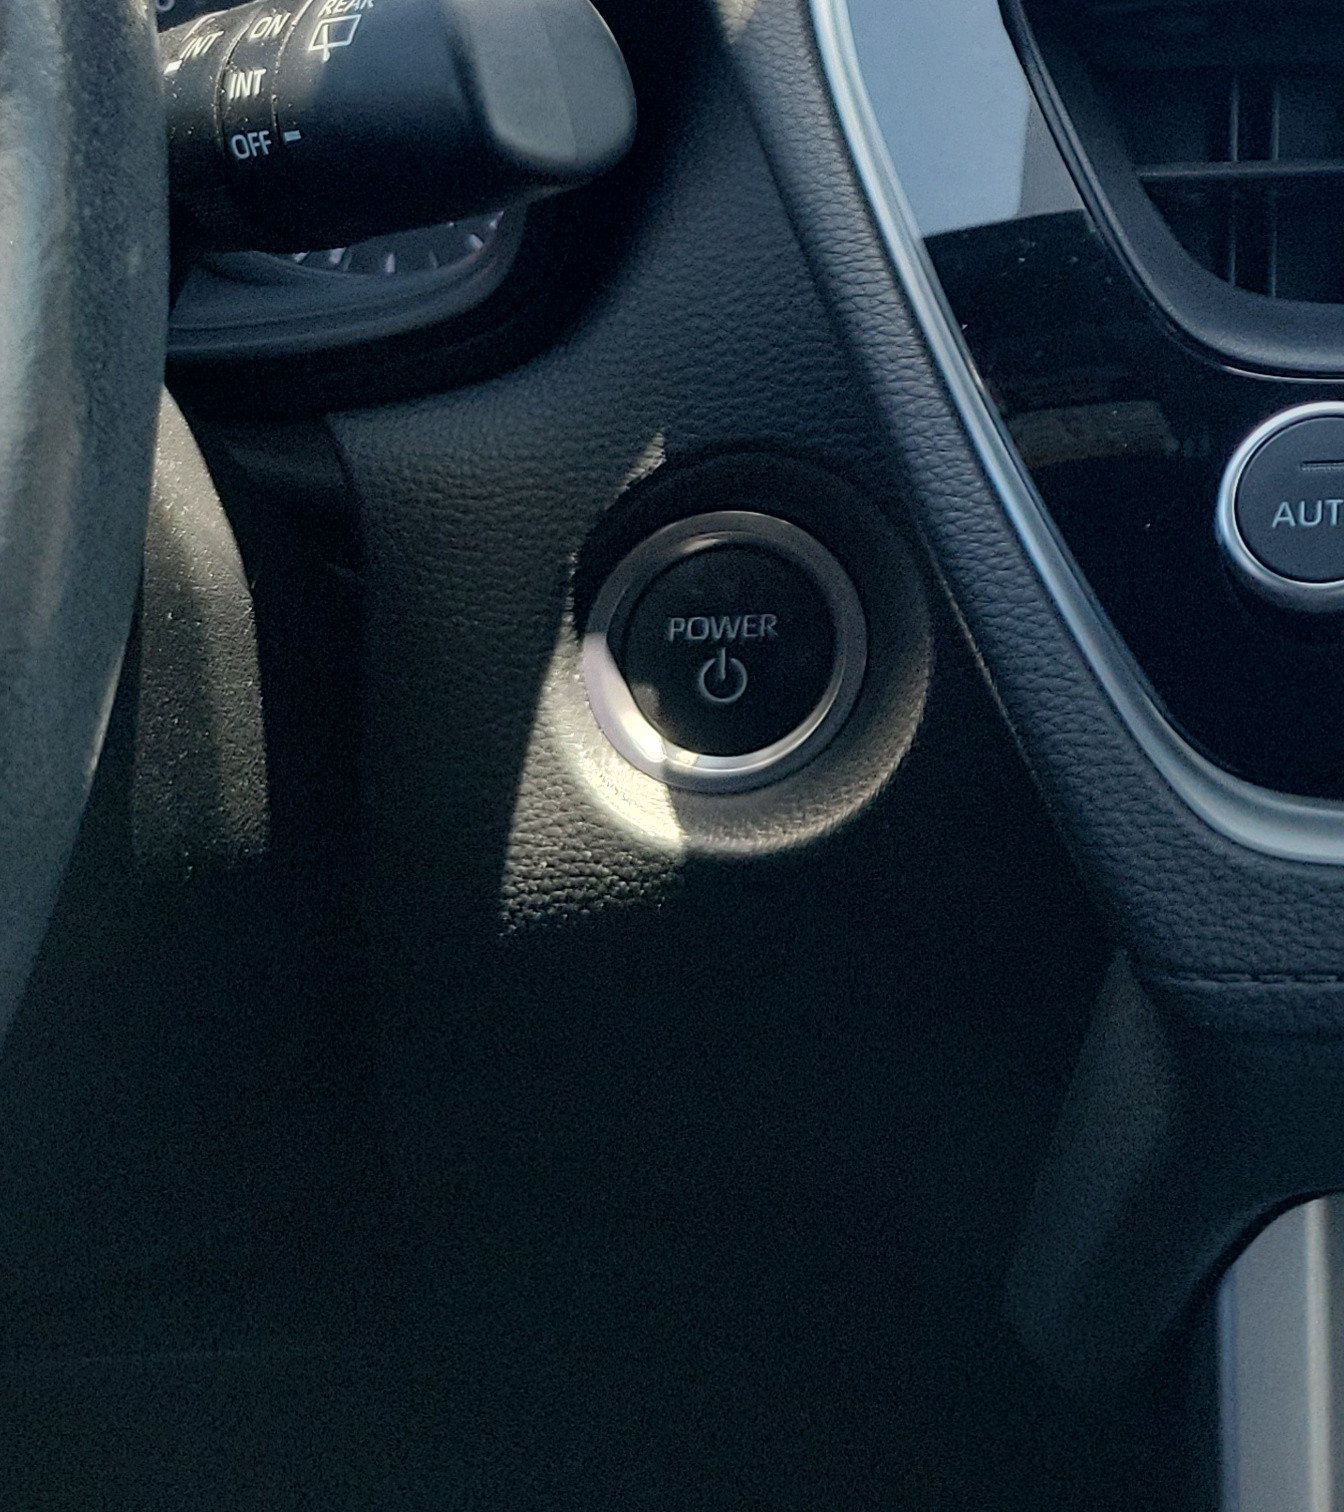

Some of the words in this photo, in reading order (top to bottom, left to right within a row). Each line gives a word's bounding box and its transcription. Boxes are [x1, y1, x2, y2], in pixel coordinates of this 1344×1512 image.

[250, 11, 292, 39] ON
[228, 67, 268, 101] INT
[230, 130, 273, 160] OFF
[667, 612, 779, 642] POWER
